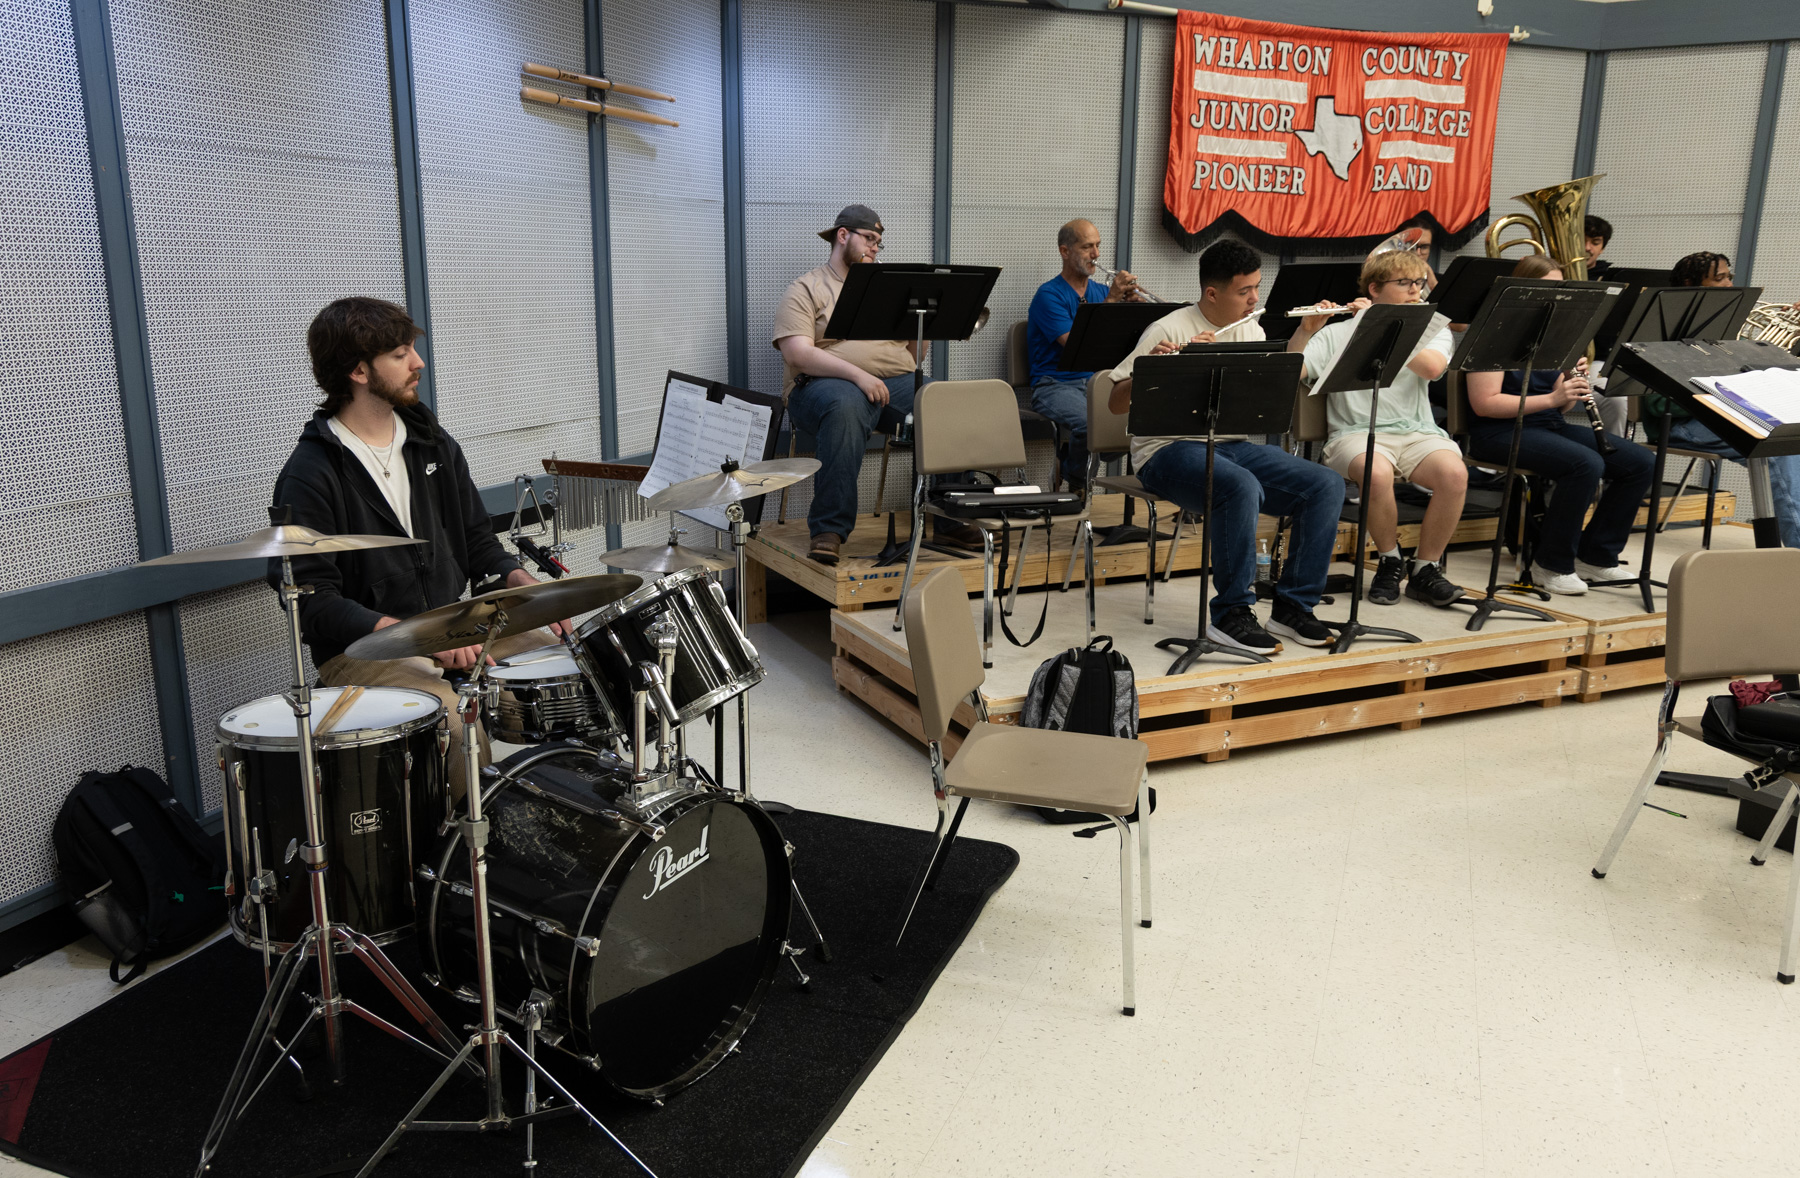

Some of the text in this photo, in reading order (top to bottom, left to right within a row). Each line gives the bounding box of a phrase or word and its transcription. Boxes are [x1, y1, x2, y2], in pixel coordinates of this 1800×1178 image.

[1193, 33, 1470, 81] WHARTON COUNTY
[1190, 99, 1471, 138] JUNIOR COLLEGE
[1192, 160, 1433, 195] PIONEER BAND
[642, 824, 710, 900] Pearl
